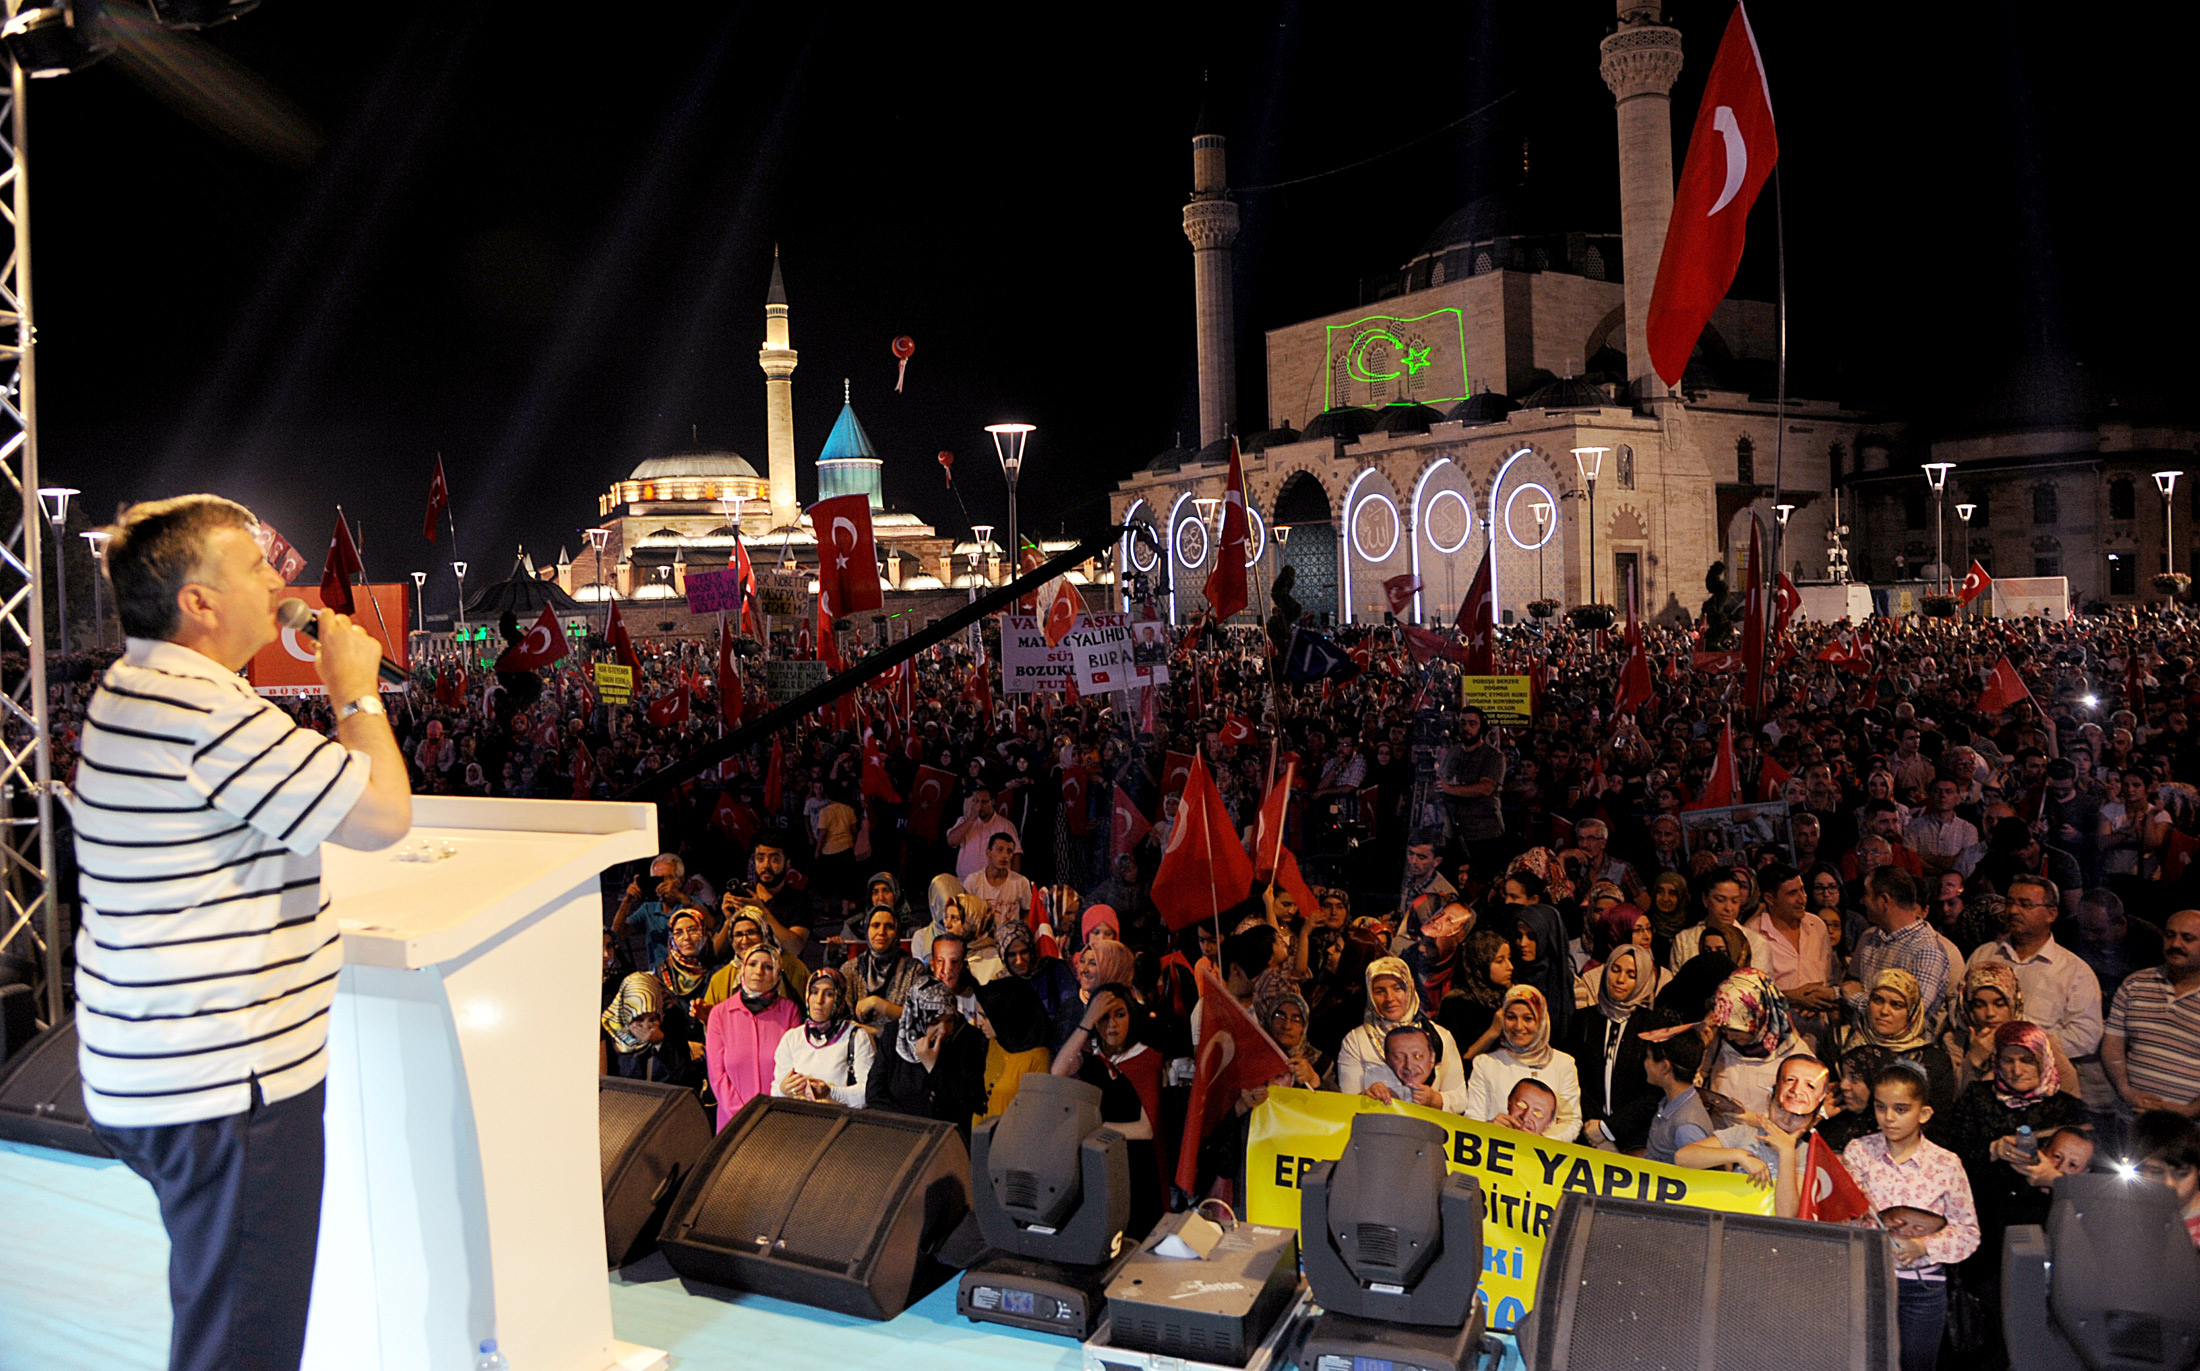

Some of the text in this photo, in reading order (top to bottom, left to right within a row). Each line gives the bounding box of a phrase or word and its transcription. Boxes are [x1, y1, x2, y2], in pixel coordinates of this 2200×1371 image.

[1010, 615, 1125, 630] VA AŞKI
[1018, 636, 1059, 648] MAY
[1071, 626, 1132, 648] YALIHÜY
[1047, 651, 1074, 662] SÜT
[1089, 649, 1133, 668] BURA
[1015, 665, 1077, 676] BOZUKL
[268, 687, 321, 695] BÜSAN
[1534, 1147, 1687, 1203] YAPIP
